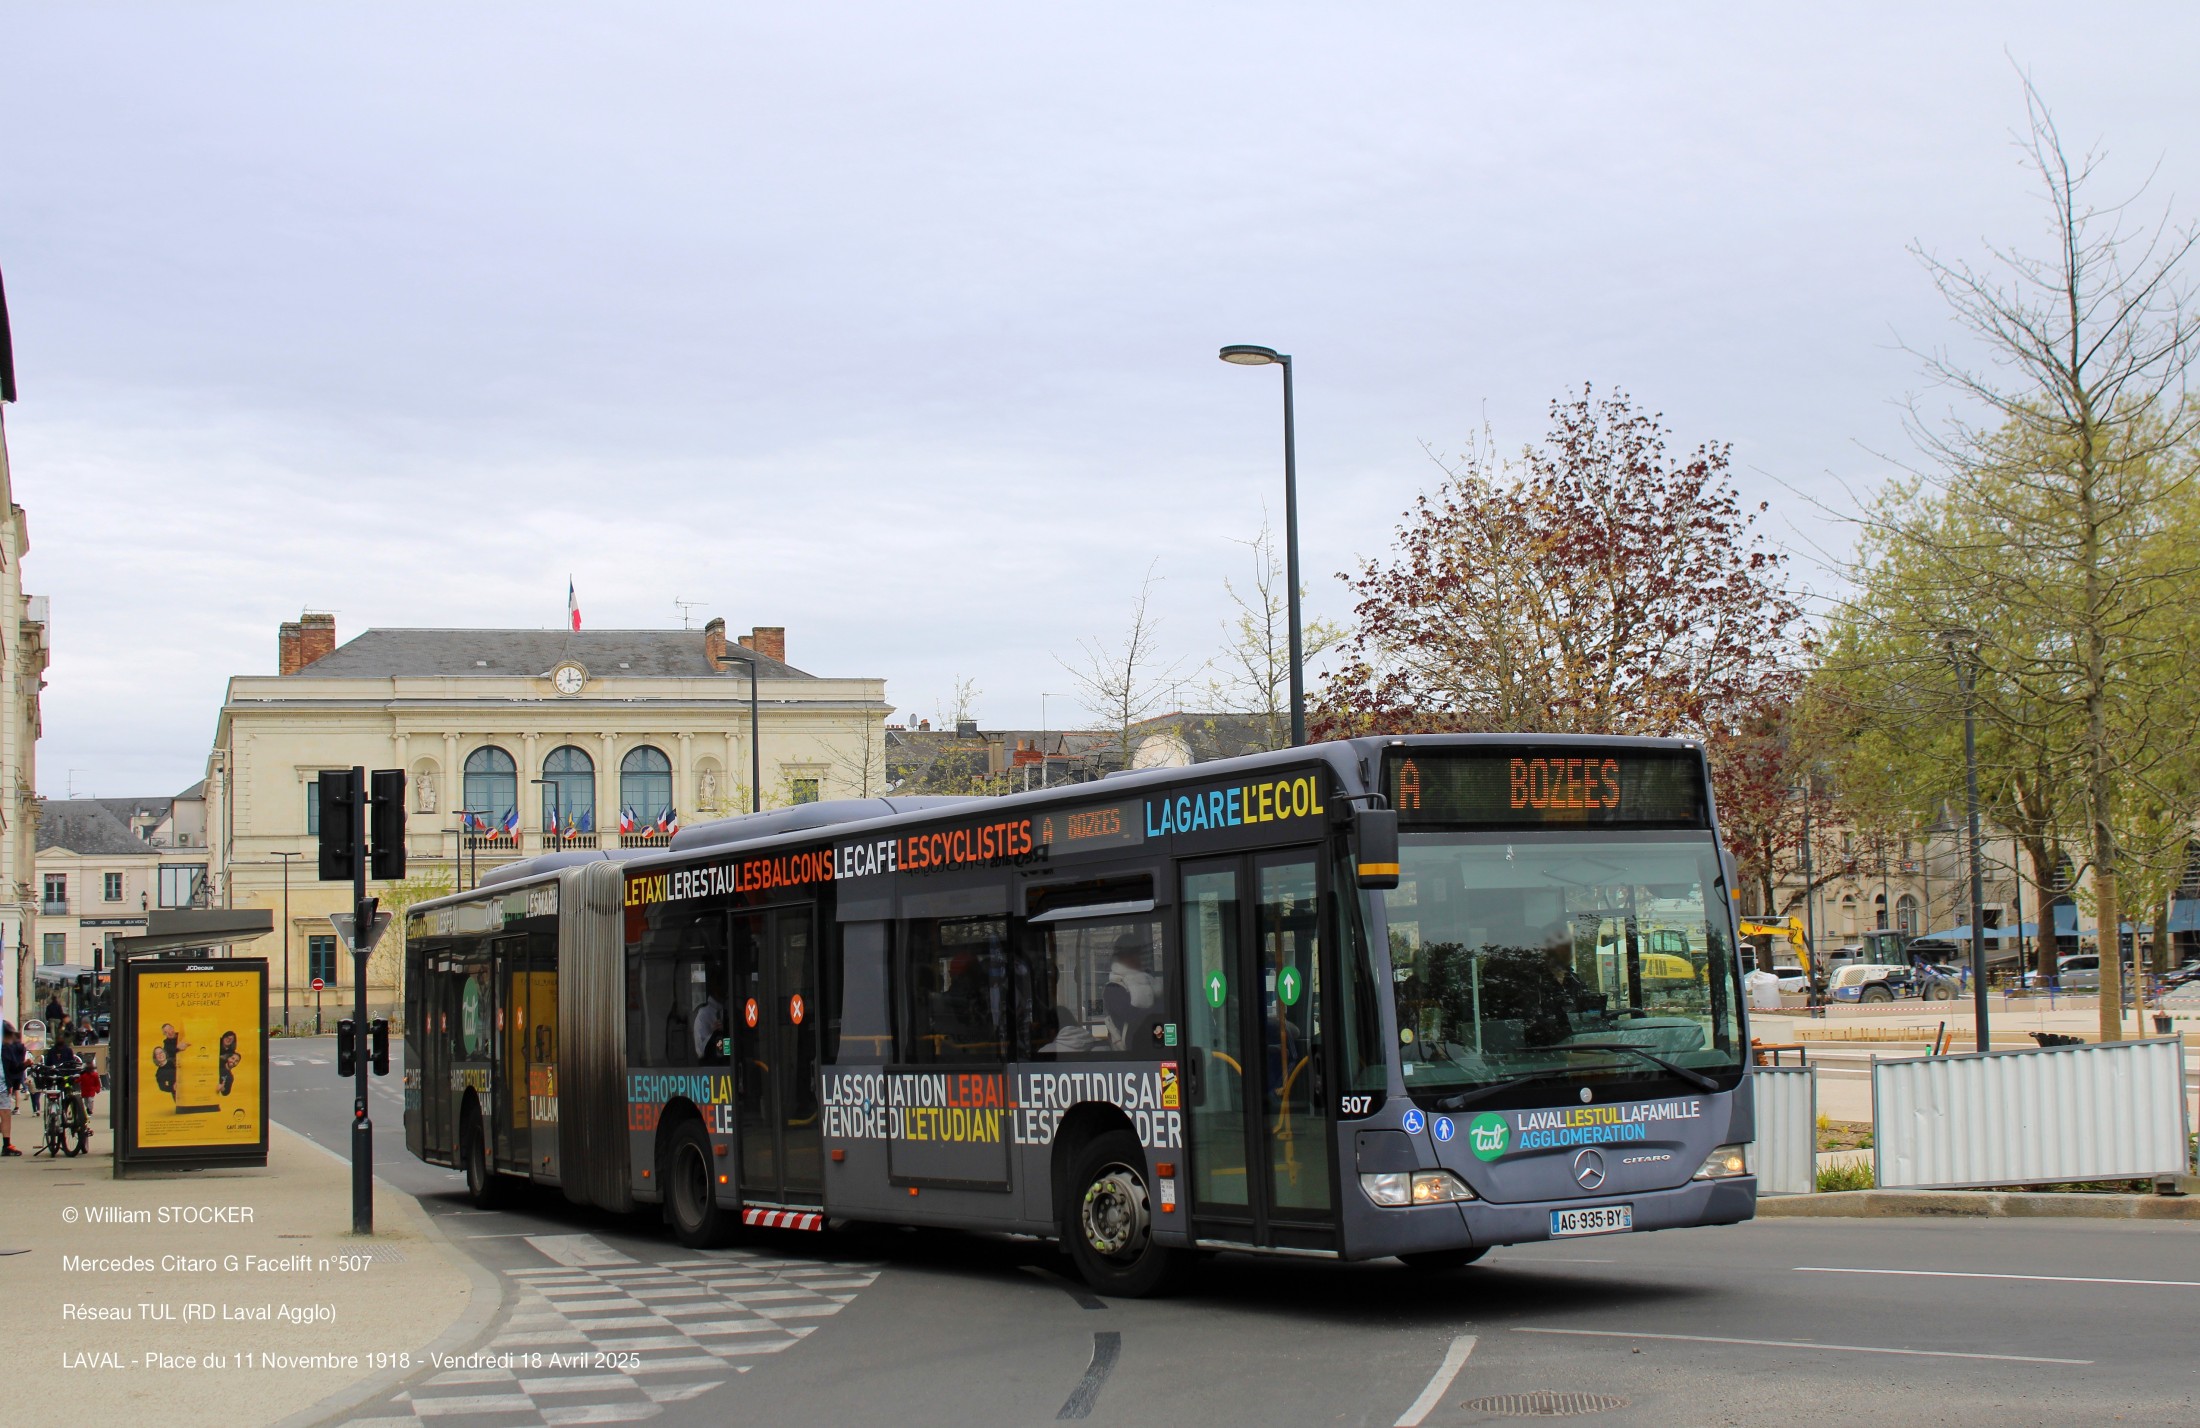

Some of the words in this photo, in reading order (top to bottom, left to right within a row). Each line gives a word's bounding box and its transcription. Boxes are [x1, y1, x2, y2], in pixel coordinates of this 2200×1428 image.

[1400, 757, 1420, 809] A
[1510, 757, 1620, 809] BOZEES
[1068, 808, 1120, 840] BOZEES
[1341, 1096, 1372, 1113] 507
[1471, 1123, 1508, 1151] tul
[1519, 1123, 1646, 1150] AGGLOMERATION
[1622, 1154, 1671, 1165] CITARO
[1561, 1209, 1621, 1231] AG-935-BY
